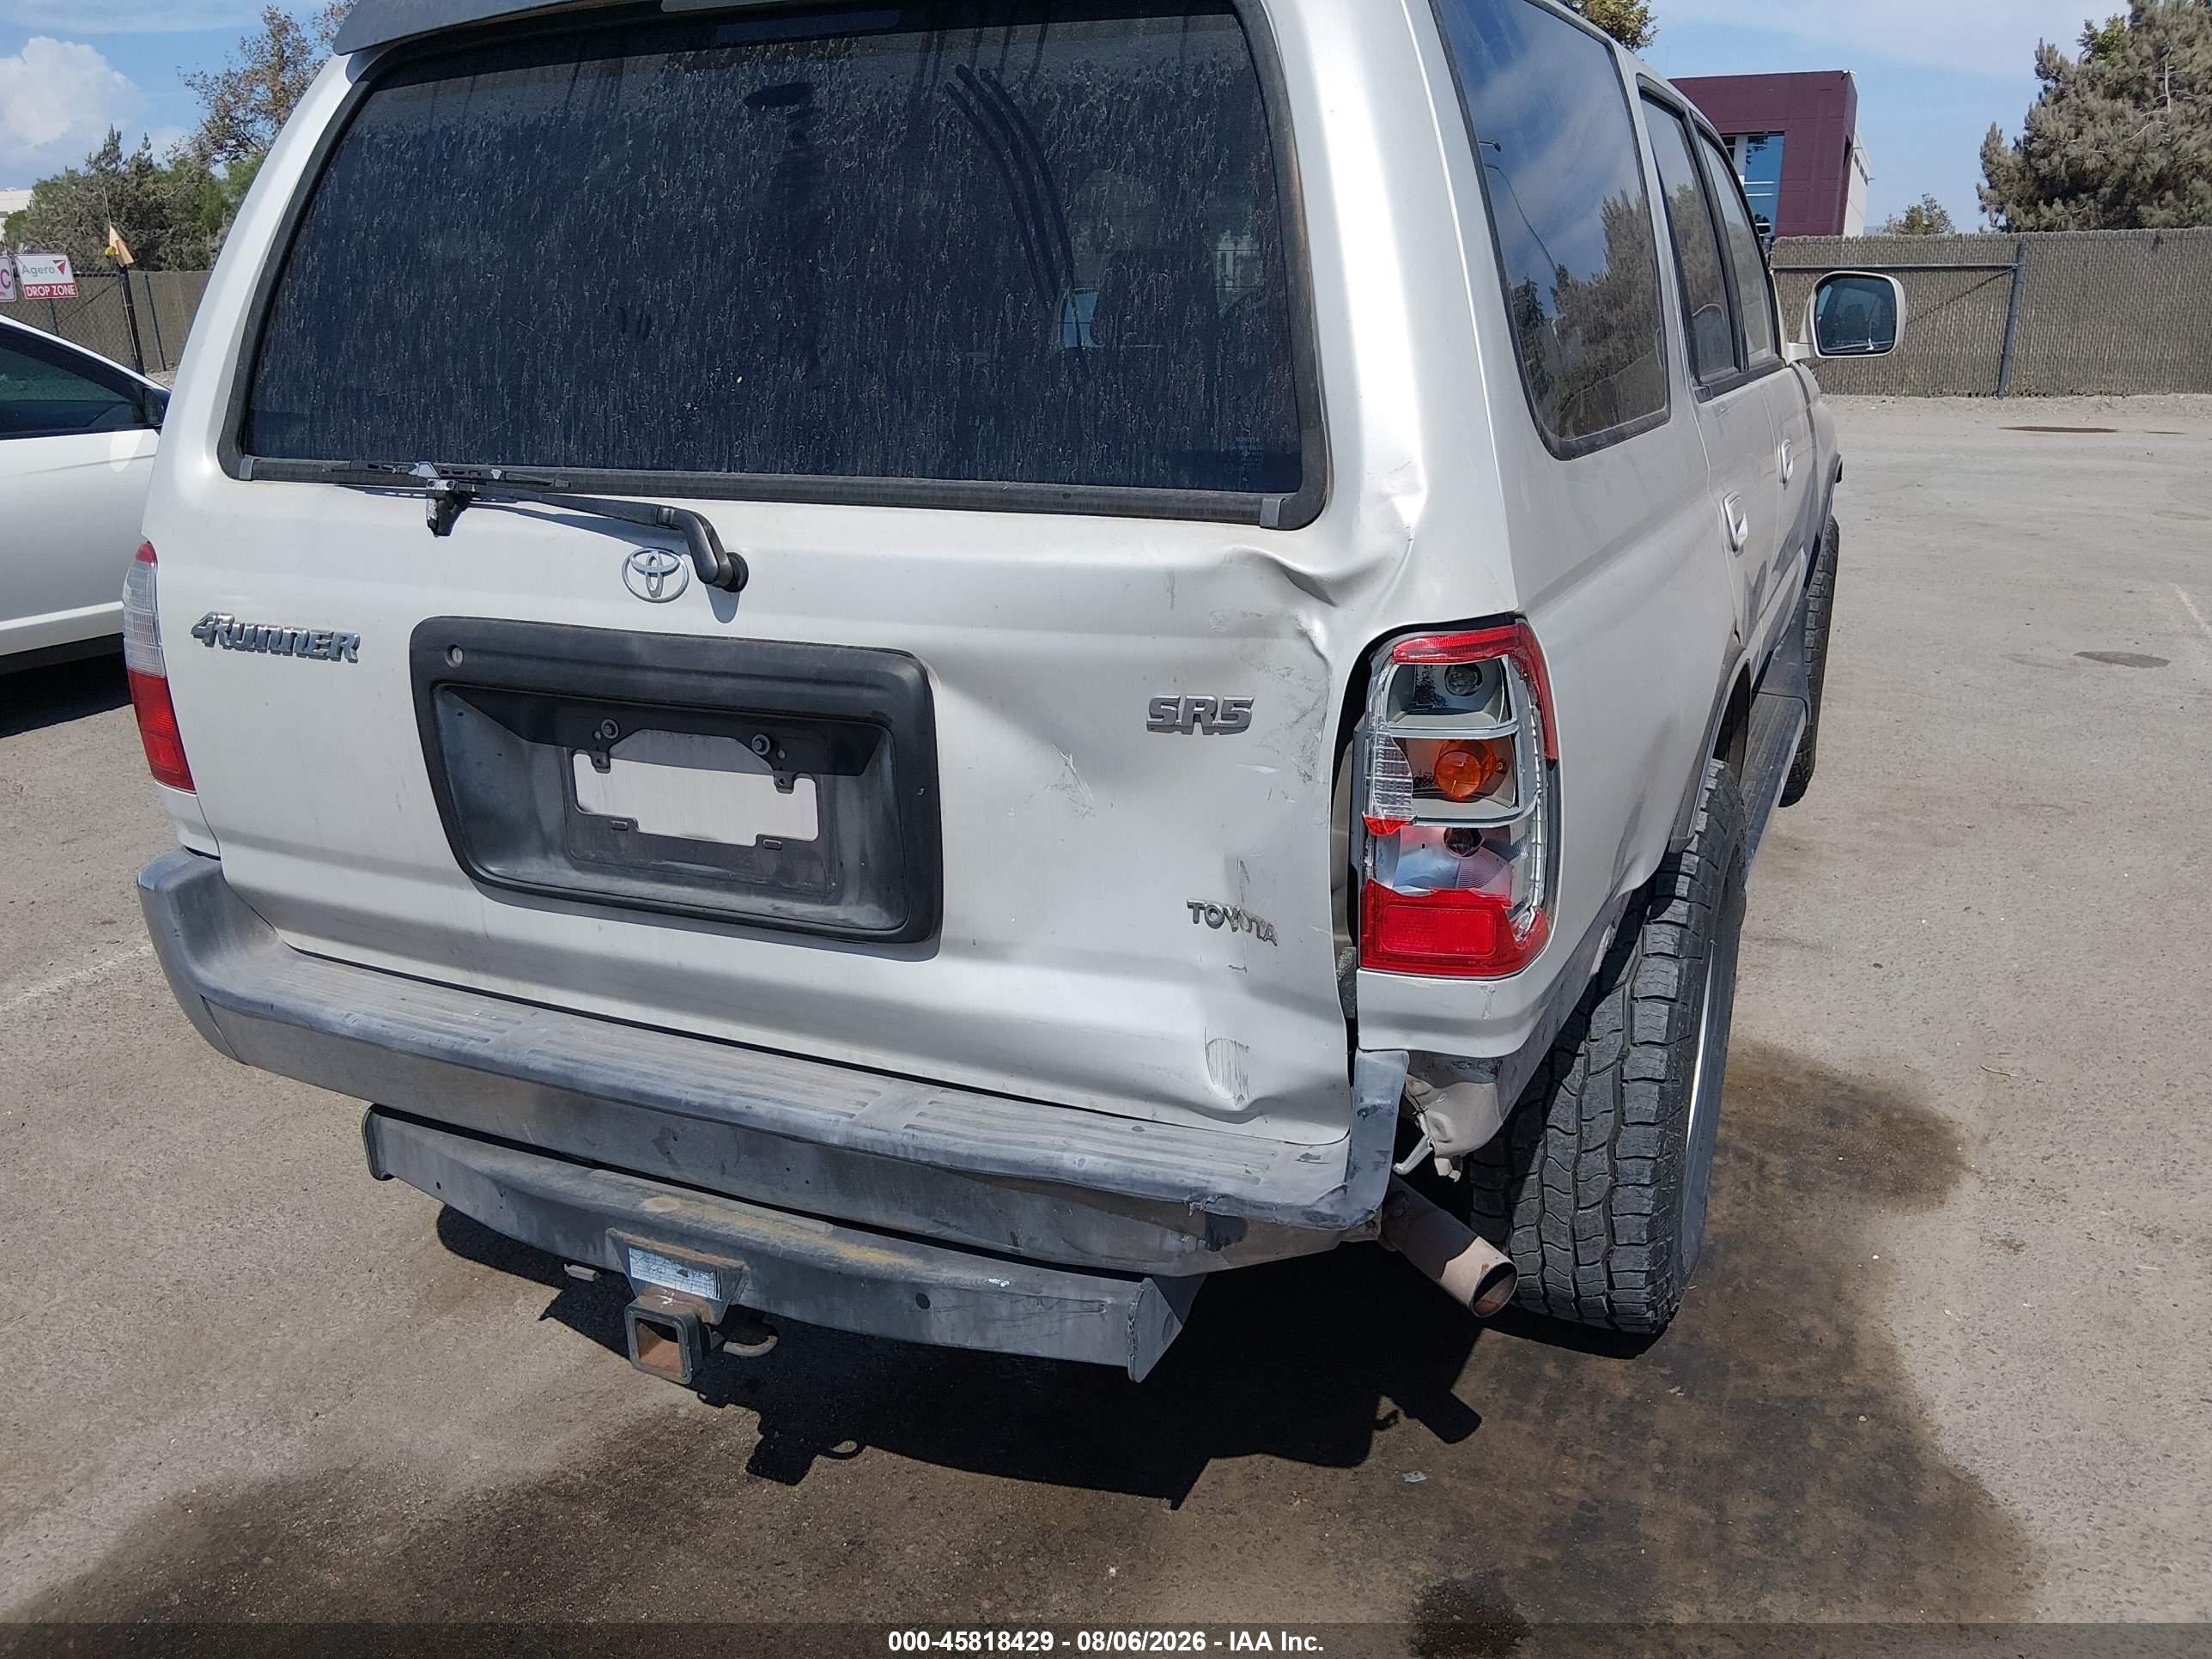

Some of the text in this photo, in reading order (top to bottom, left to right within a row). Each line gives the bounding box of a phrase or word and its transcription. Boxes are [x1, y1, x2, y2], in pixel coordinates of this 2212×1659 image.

[22, 264, 56, 277] Agero
[25, 284, 76, 297] DROP ZONE
[1146, 694, 1255, 736] SR5
